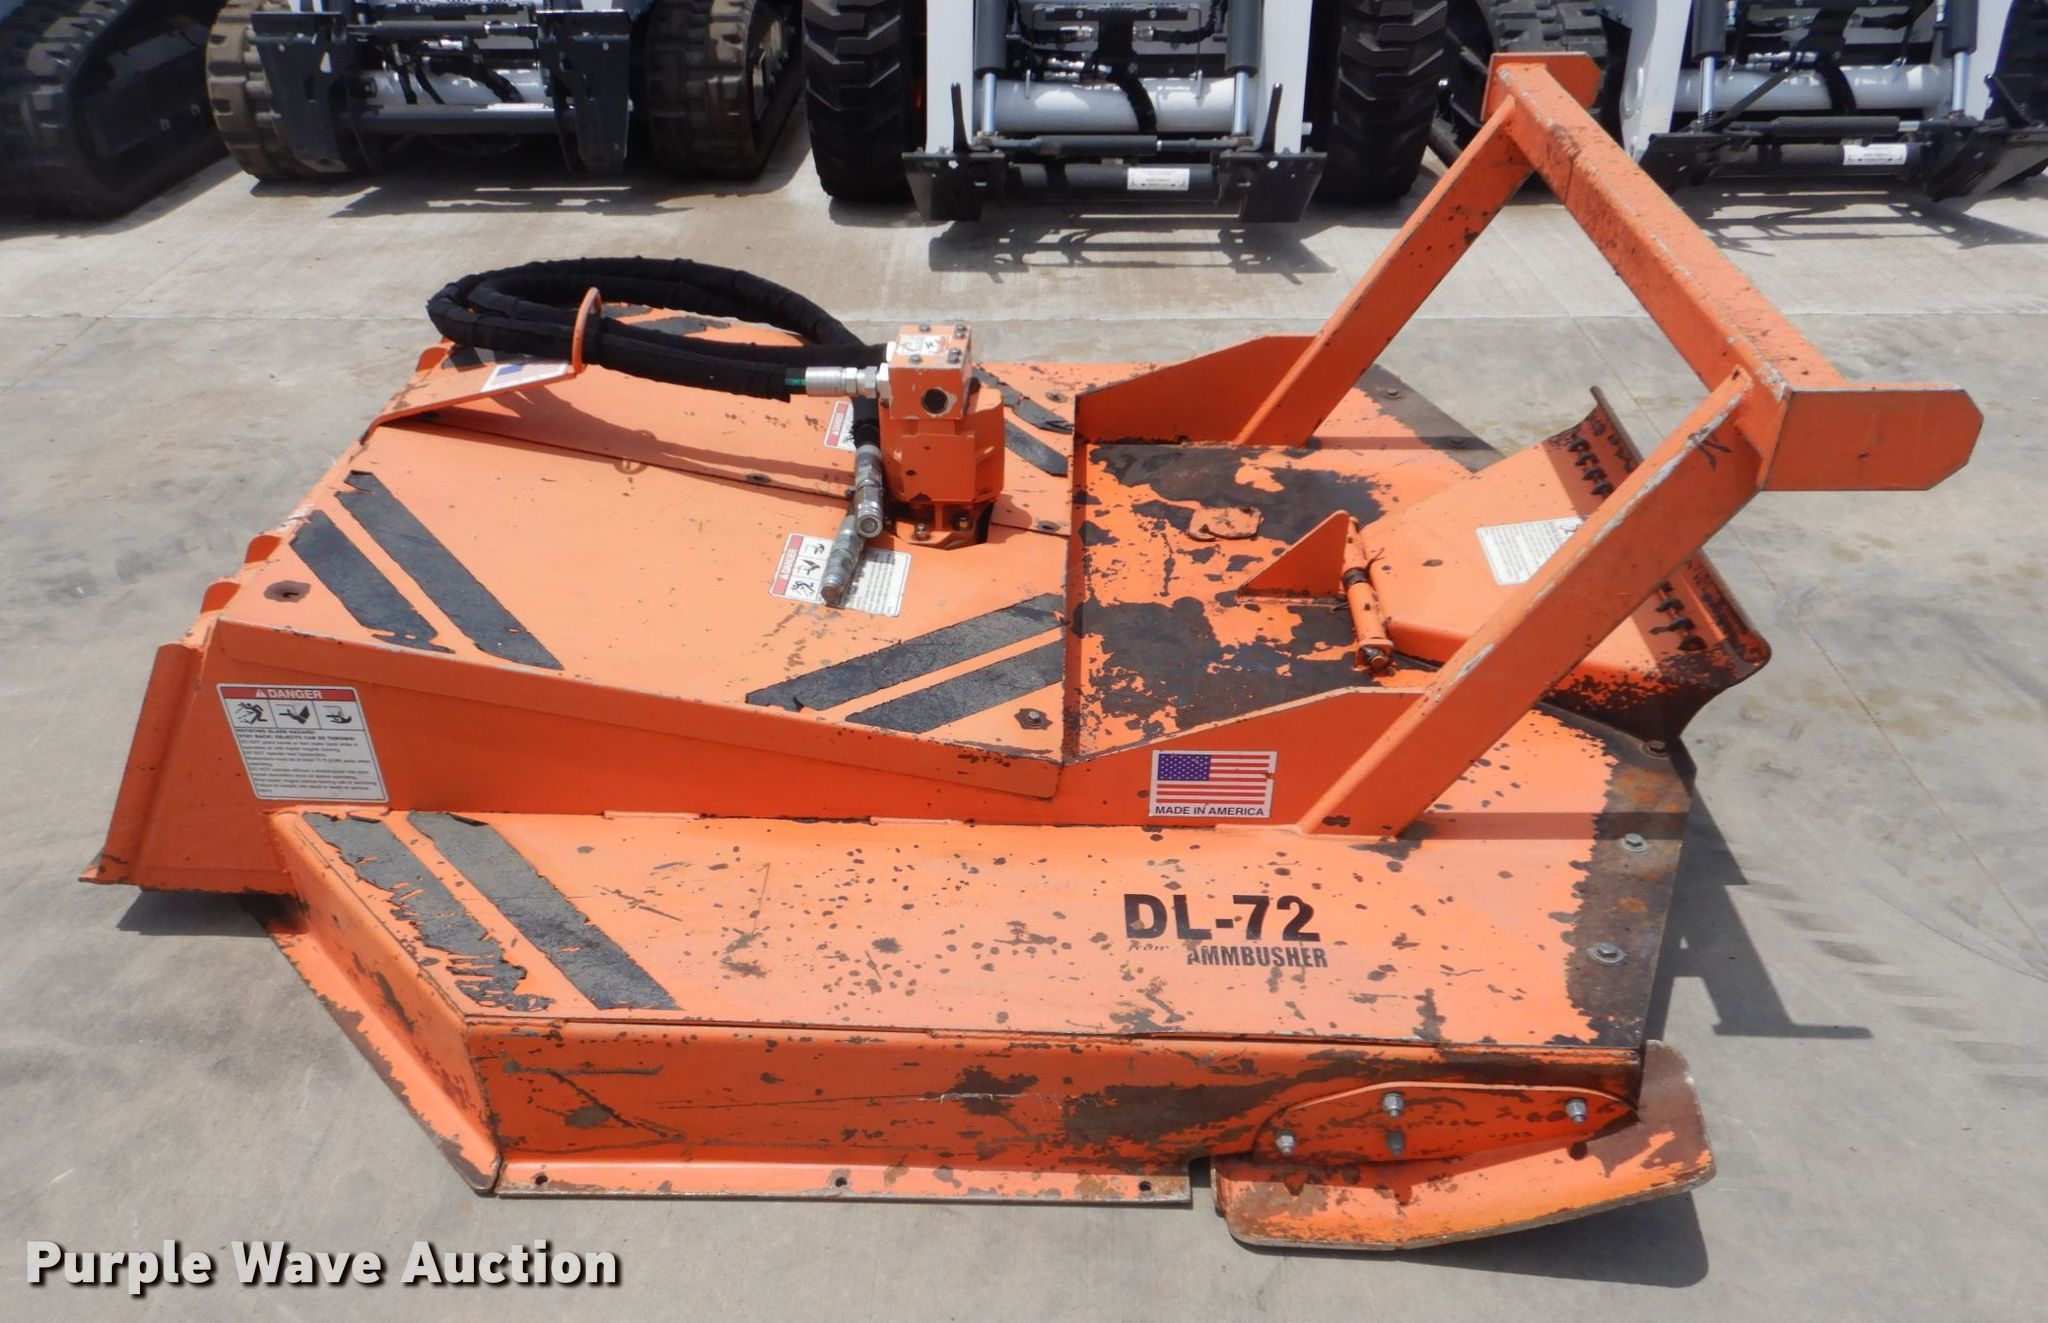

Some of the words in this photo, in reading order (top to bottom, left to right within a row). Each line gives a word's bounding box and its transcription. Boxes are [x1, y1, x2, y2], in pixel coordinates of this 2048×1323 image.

[268, 688, 323, 700] DANGER
[1155, 806, 1190, 815] MADE
[1193, 806, 1205, 815] IN
[1208, 807, 1264, 816] AMERICA
[1124, 893, 1320, 942] DL-72
[1187, 945, 1328, 968] AMMBUSHER
